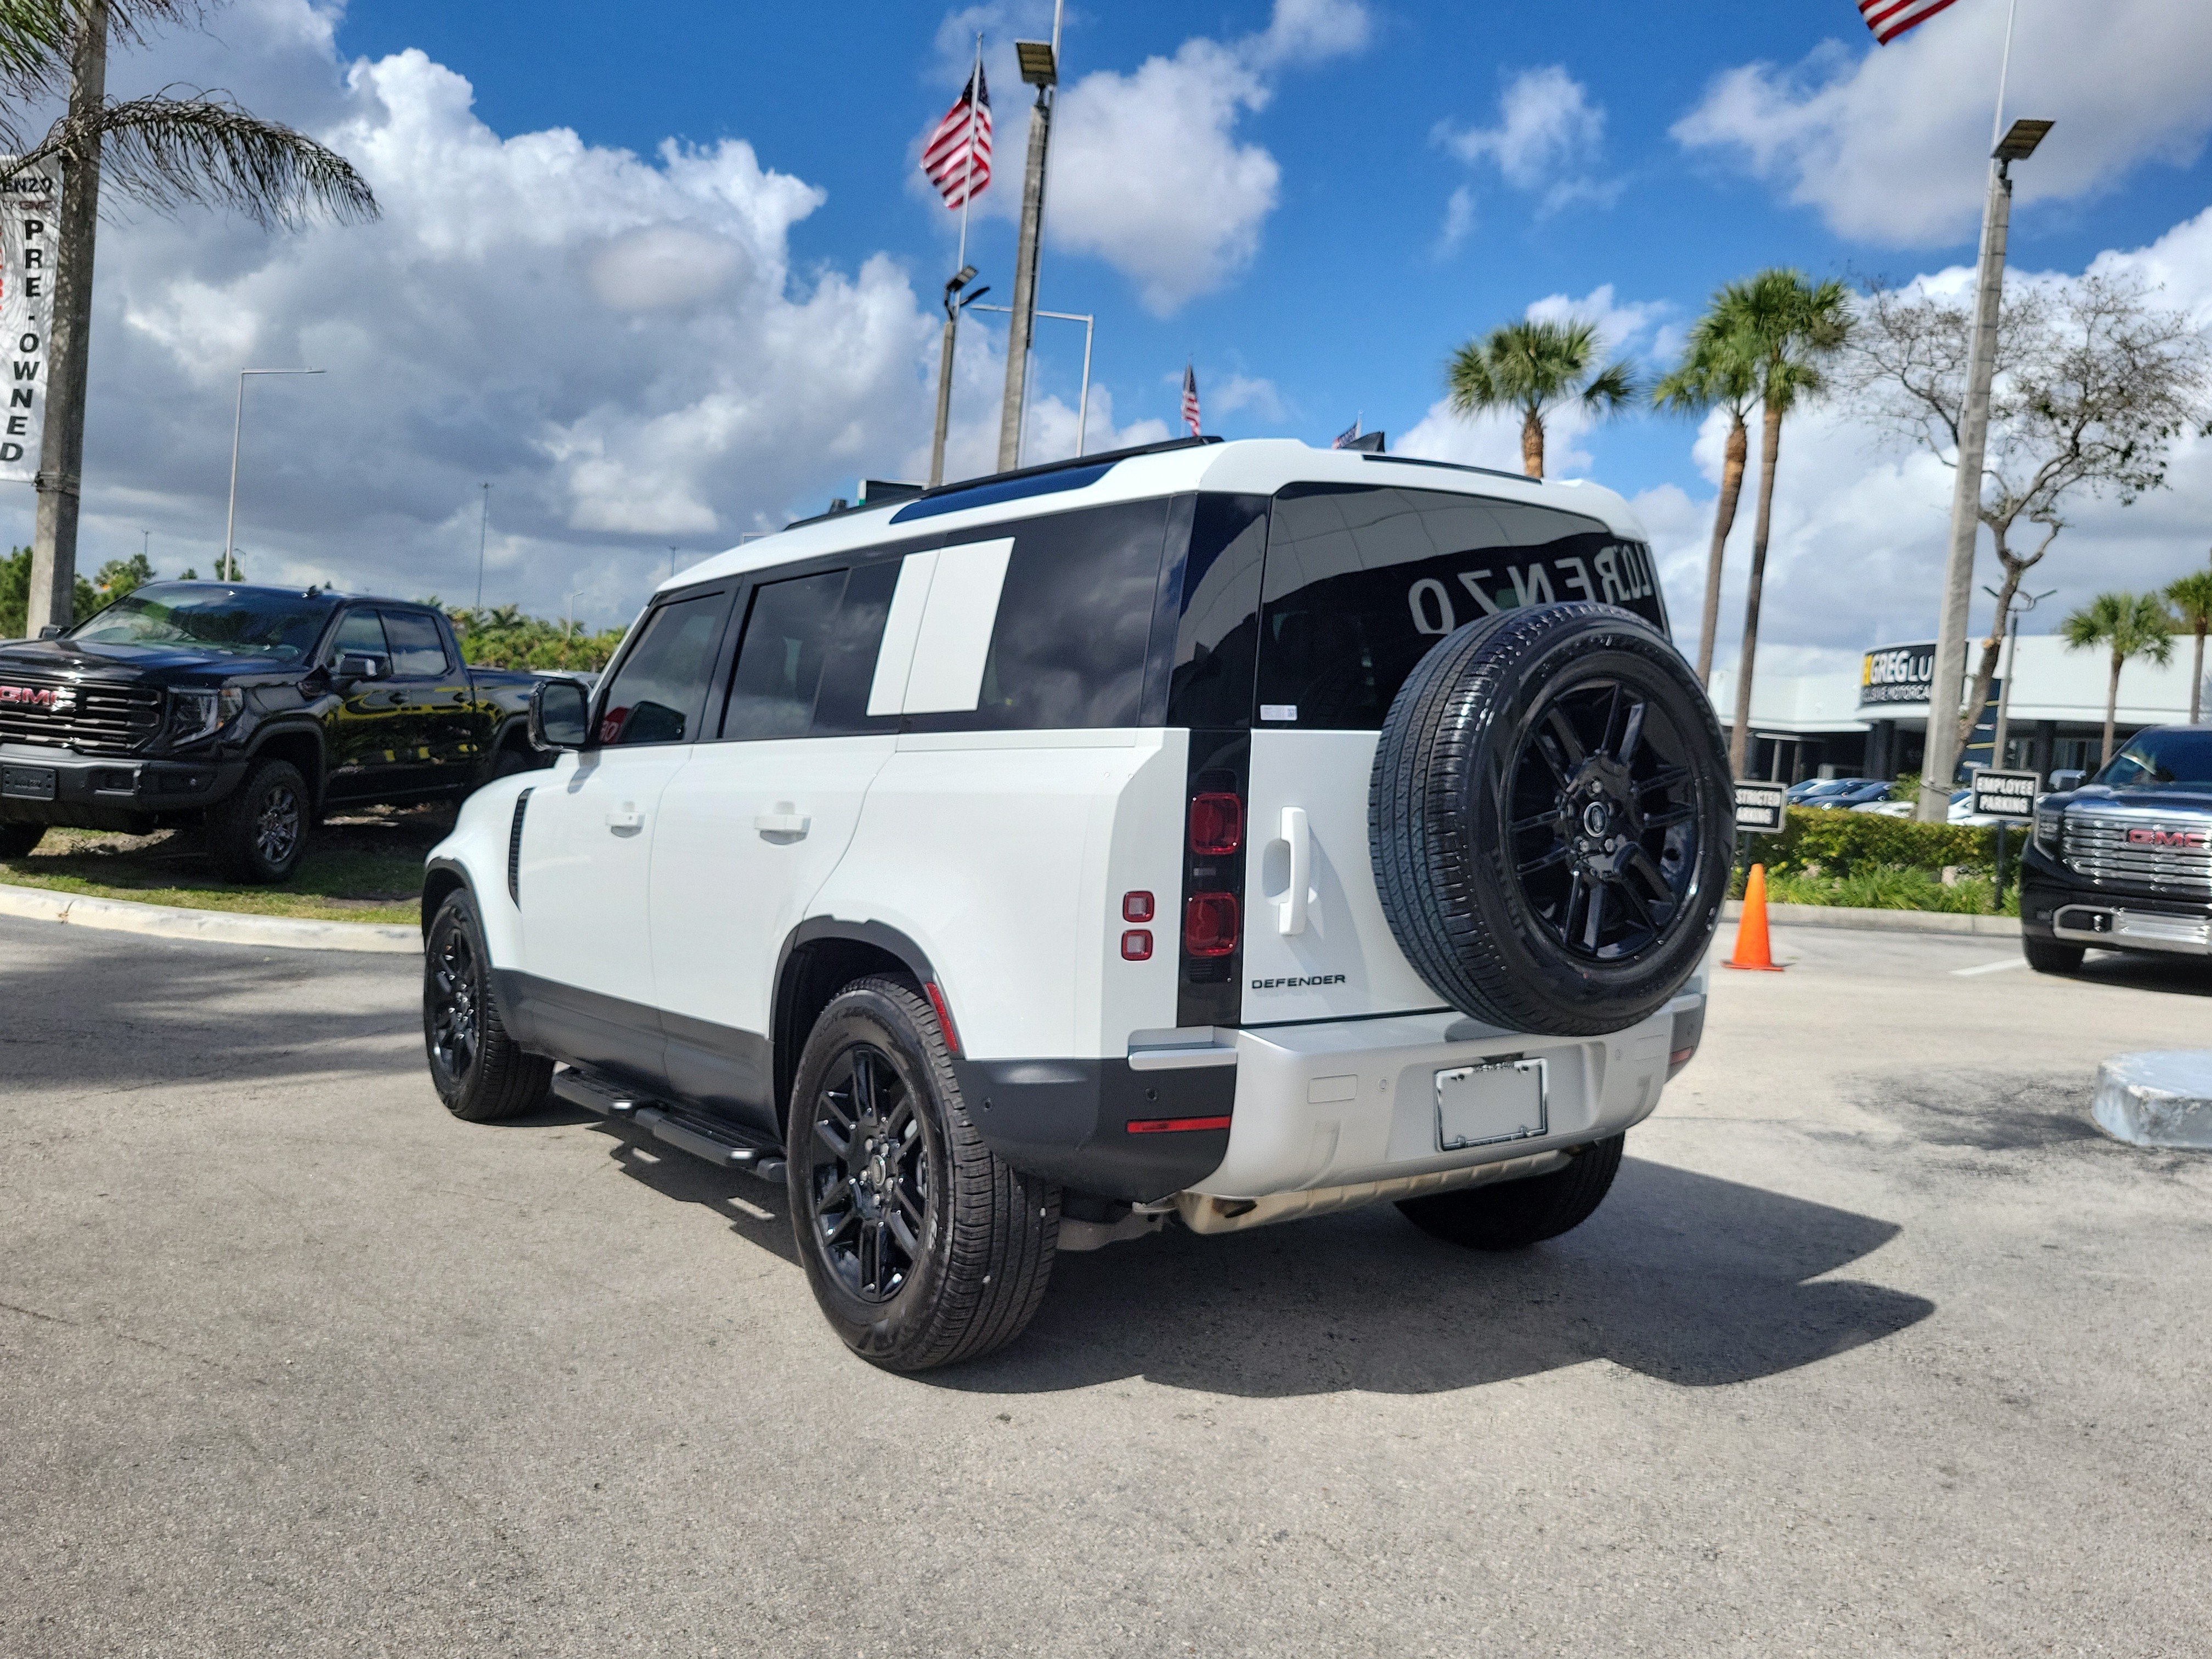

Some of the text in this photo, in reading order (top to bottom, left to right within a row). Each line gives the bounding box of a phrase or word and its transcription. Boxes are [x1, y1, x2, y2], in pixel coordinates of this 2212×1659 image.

[2, 177, 53, 193] ENZO
[0, 686, 77, 708] GMC
[1976, 777, 2034, 796] EMPLOYEE
[1735, 789, 1781, 807] STRICTED
[1979, 794, 2029, 814] PARKING
[1736, 806, 1773, 824] ARKING
[2129, 830, 2210, 848] GMC
[1252, 974, 1345, 989] DEFENDER
